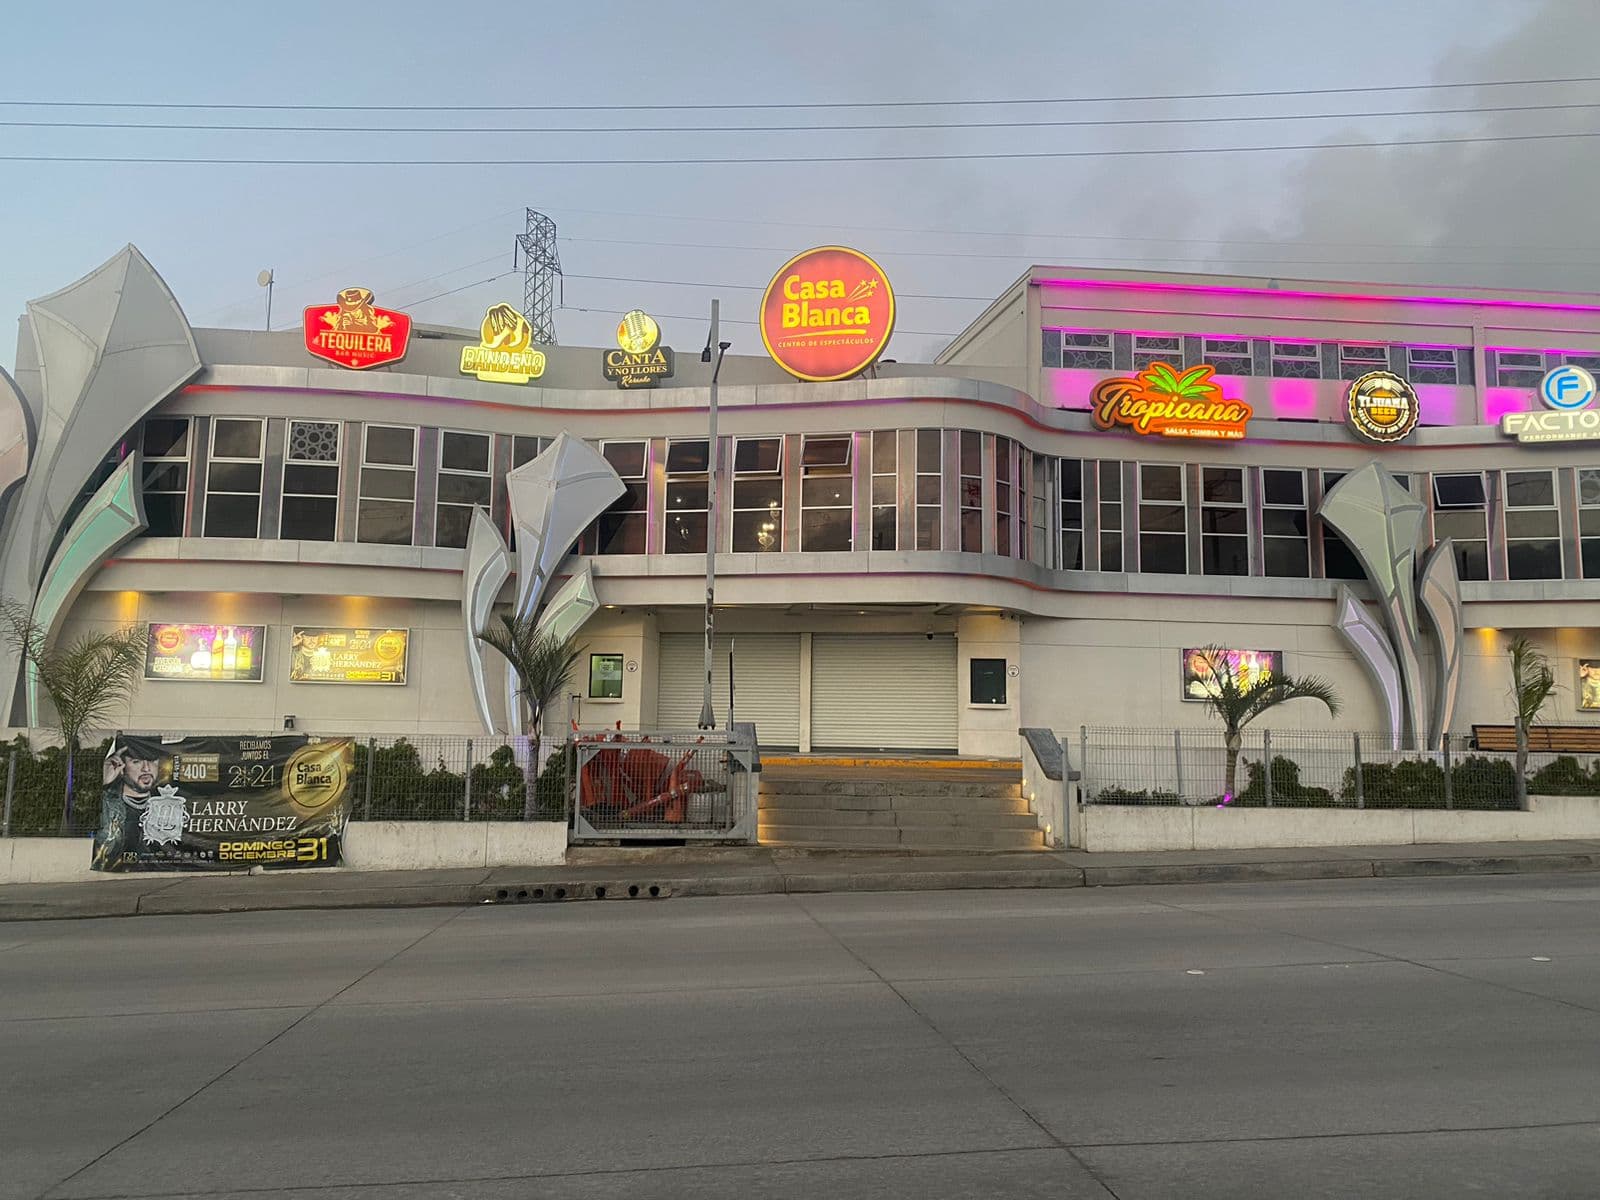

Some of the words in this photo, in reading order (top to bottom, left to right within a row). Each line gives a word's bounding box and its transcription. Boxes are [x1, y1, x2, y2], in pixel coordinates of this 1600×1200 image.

[783, 275, 845, 300] Casa
[782, 301, 870, 328] Blanca
[320, 332, 392, 352] TEQUILERA
[607, 348, 667, 366] CANTA
[608, 367, 614, 375] Y
[615, 367, 629, 375] NO
[630, 366, 668, 375] LLORES
[1100, 383, 1246, 428] Tropicana
[1357, 395, 1409, 409] TIJUANA
[1165, 427, 1188, 436] SALSA
[333, 653, 358, 661] LARRY
[381, 671, 396, 681] 31
[240, 740, 272, 751] RECIBAMOS
[241, 751, 262, 760] JUNTOS
[297, 762, 322, 772] Casa
[296, 773, 332, 785] Blanca
[191, 800, 248, 816] LARRY
[188, 815, 297, 832] HERNÁNDEZ
[219, 840, 296, 851] DOMINGO
[297, 837, 328, 861] 31
[219, 850, 297, 860] DICIEMBRE
